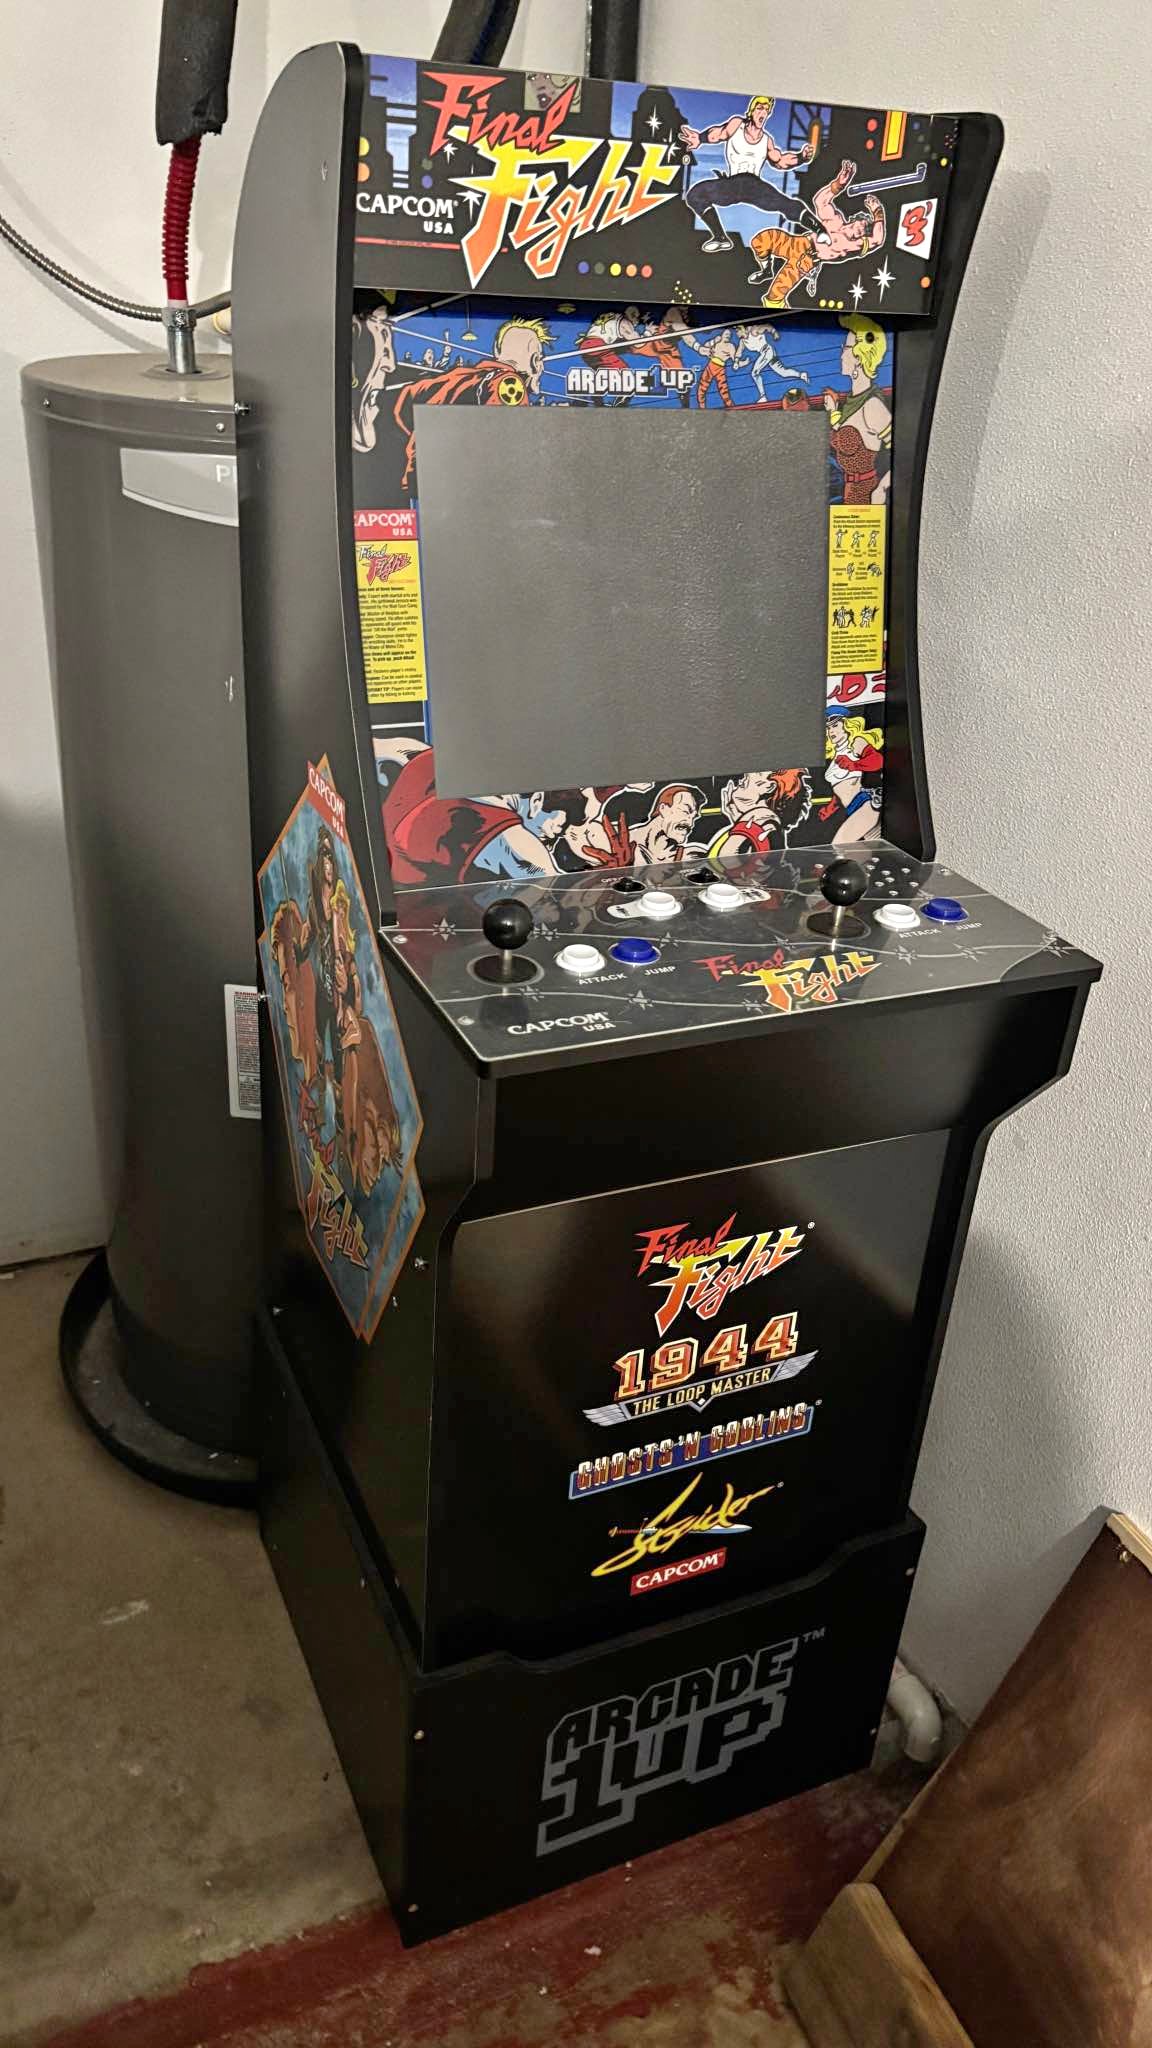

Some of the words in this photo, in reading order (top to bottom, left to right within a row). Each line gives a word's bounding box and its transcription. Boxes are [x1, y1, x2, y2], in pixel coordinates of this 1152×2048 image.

[423, 70, 581, 157] Final
[356, 192, 455, 219] CAPCOM
[423, 221, 454, 235] USA
[447, 126, 682, 289] Fight
[393, 528, 413, 537] USA
[308, 767, 345, 823] CAPCOM
[898, 928, 942, 938] ATTACK
[955, 922, 983, 931] JUMP
[577, 972, 628, 985] ATTACK
[643, 965, 677, 976] JUMP
[691, 947, 785, 983] Final
[721, 951, 882, 1013] Fight
[507, 1012, 610, 1035] CAPCOM
[582, 1021, 616, 1032] USA
[634, 1211, 736, 1278] Final
[648, 1224, 809, 1337] Fight
[613, 1310, 799, 1400] 1944
[632, 1393, 661, 1416] THE
[666, 1383, 706, 1408] LOOP
[710, 1367, 773, 1396] MASTER
[576, 1439, 674, 1492] GHOSTS
[709, 1401, 810, 1453] GOBLINS
[635, 1553, 720, 1590] CAPCOM
[548, 1637, 800, 1762] ARCADE
[536, 1689, 788, 1857] 1UP
